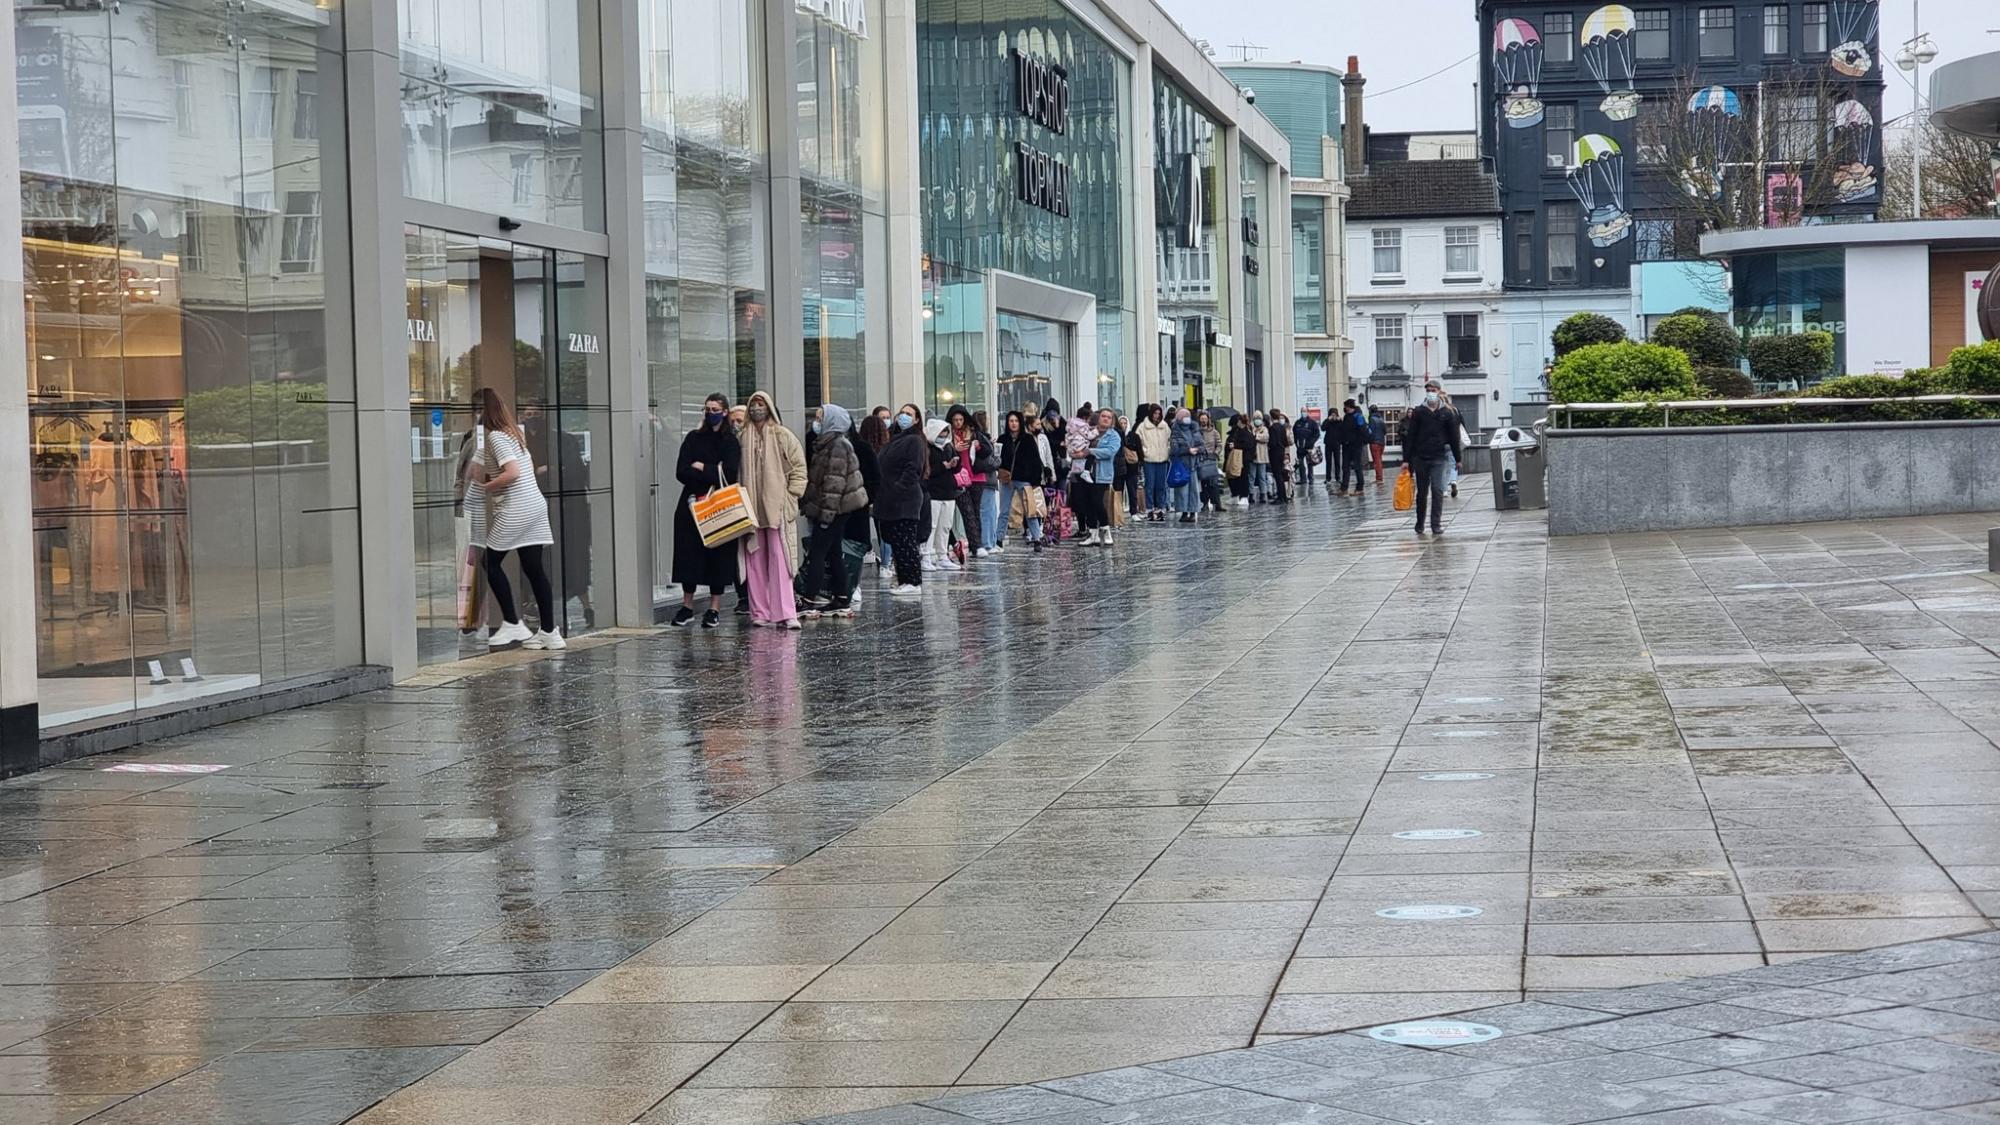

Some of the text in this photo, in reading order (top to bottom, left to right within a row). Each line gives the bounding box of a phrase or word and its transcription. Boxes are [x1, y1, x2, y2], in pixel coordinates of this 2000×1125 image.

[1017, 49, 1069, 134] TOPSHOP
[1020, 142, 1071, 217] TOPMAN
[406, 319, 436, 342] ARA
[568, 333, 600, 353] ZARA
